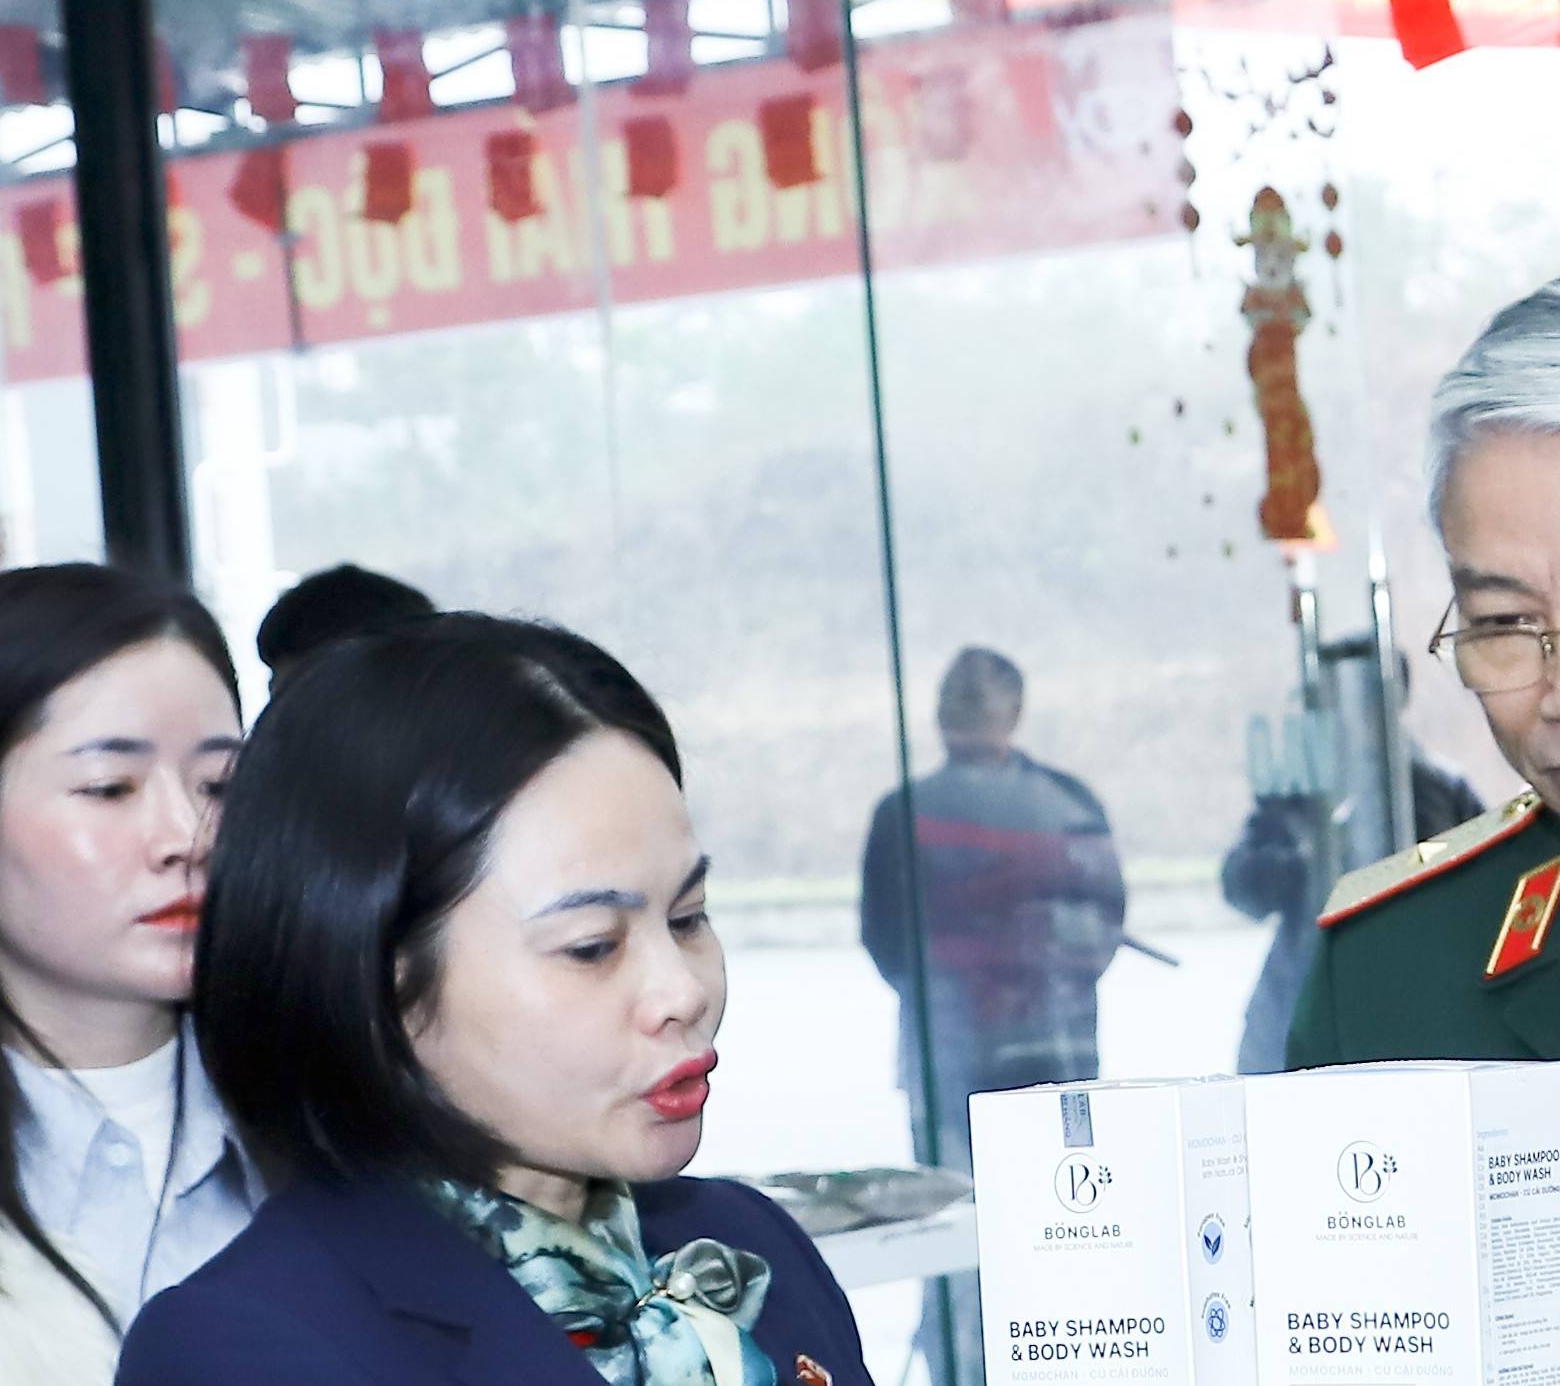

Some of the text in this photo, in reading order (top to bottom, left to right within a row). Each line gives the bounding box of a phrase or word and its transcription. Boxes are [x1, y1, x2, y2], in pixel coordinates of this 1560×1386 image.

[1488, 1149, 1560, 1170] BABY SHAMPOO
[1496, 1170, 1522, 1185] BODY
[1523, 1167, 1551, 1181] WASH
[1328, 1211, 1406, 1229] BÖNGLAB
[1044, 1221, 1121, 1240] BÖNGLAB
[1009, 1317, 1165, 1338] BABY SHAMPOO
[1287, 1312, 1450, 1330] BABY SHAMPOO
[1011, 1341, 1149, 1362] & BODY WASH
[1288, 1336, 1433, 1354] & BODY WASH
